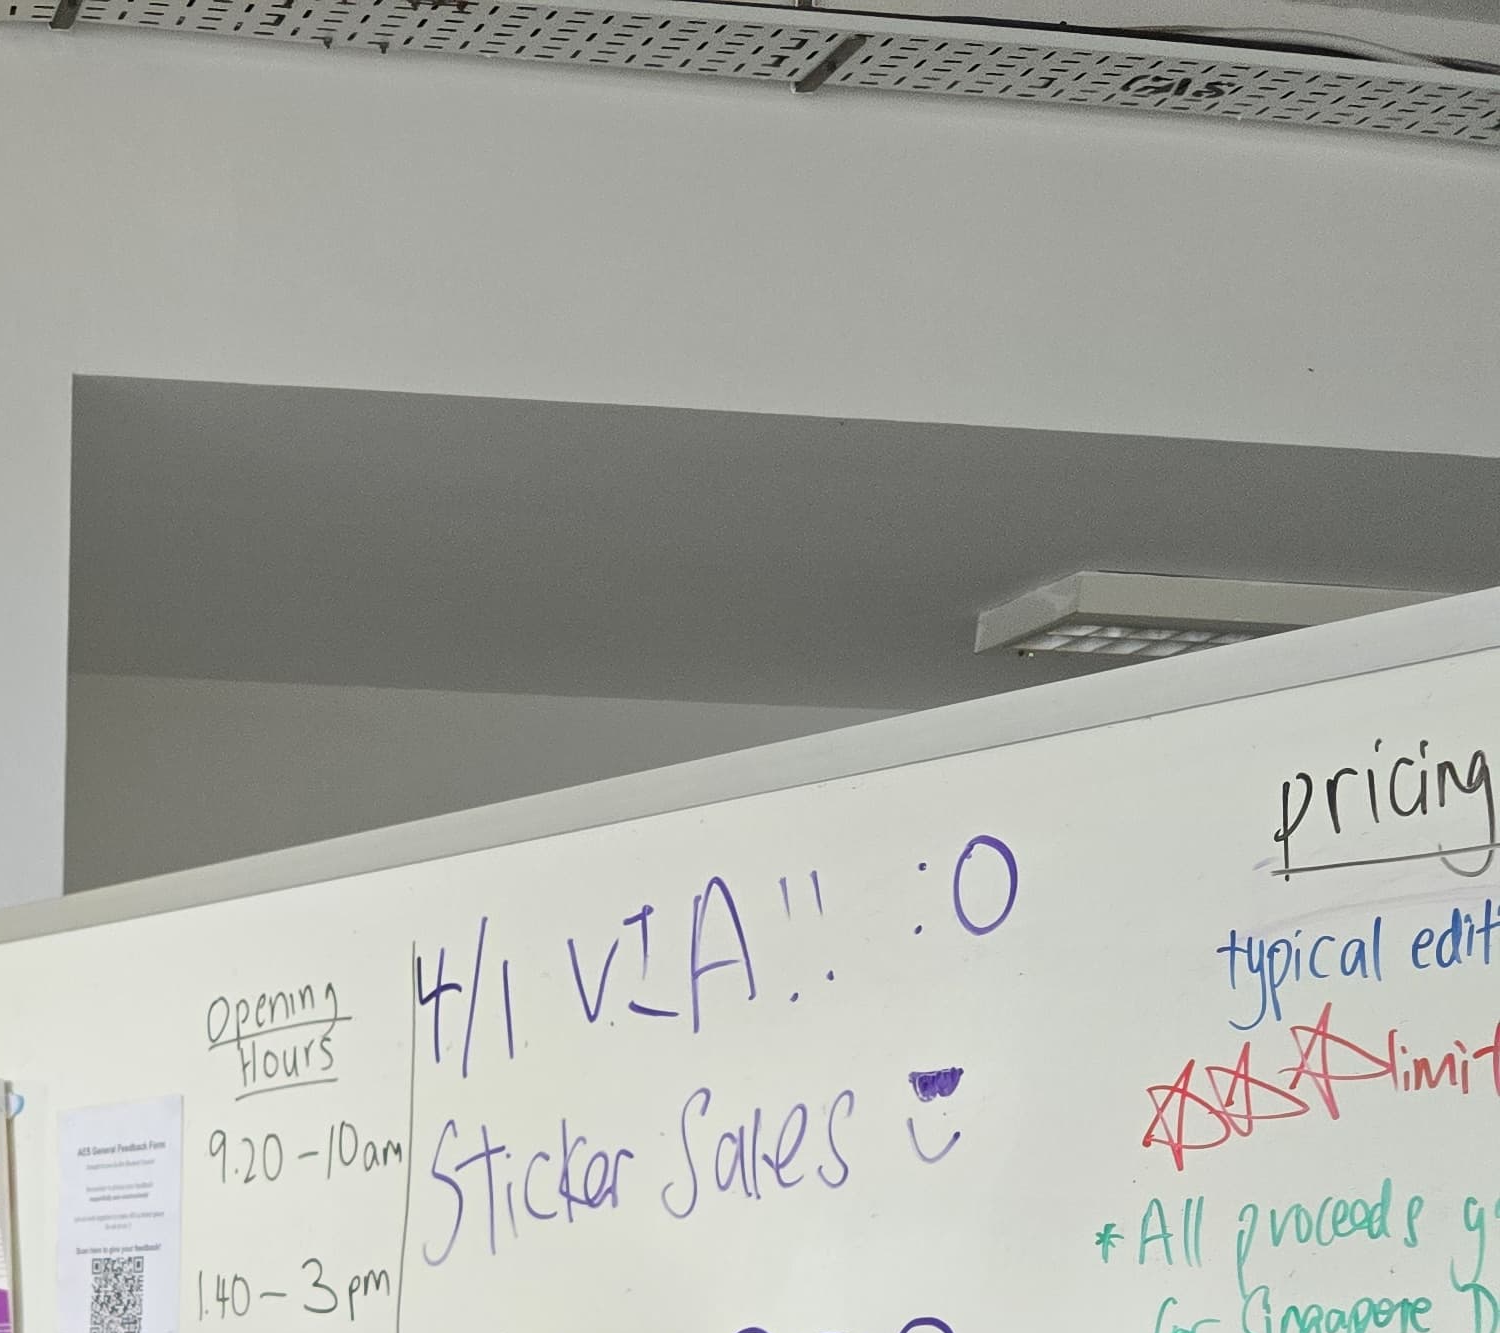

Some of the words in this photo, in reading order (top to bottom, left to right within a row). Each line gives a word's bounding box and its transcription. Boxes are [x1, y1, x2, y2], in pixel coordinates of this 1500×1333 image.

[1273, 738, 1496, 882] pricing
[207, 982, 340, 1051] Opening
[417, 915, 514, 1078] 4/1
[1216, 916, 1382, 1031] typical
[1411, 898, 1500, 970] edit
[240, 1036, 334, 1088] Hours
[422, 1118, 635, 1267] Sticker
[661, 1086, 856, 1220] Sales
[1236, 1177, 1425, 1300] proceeds
